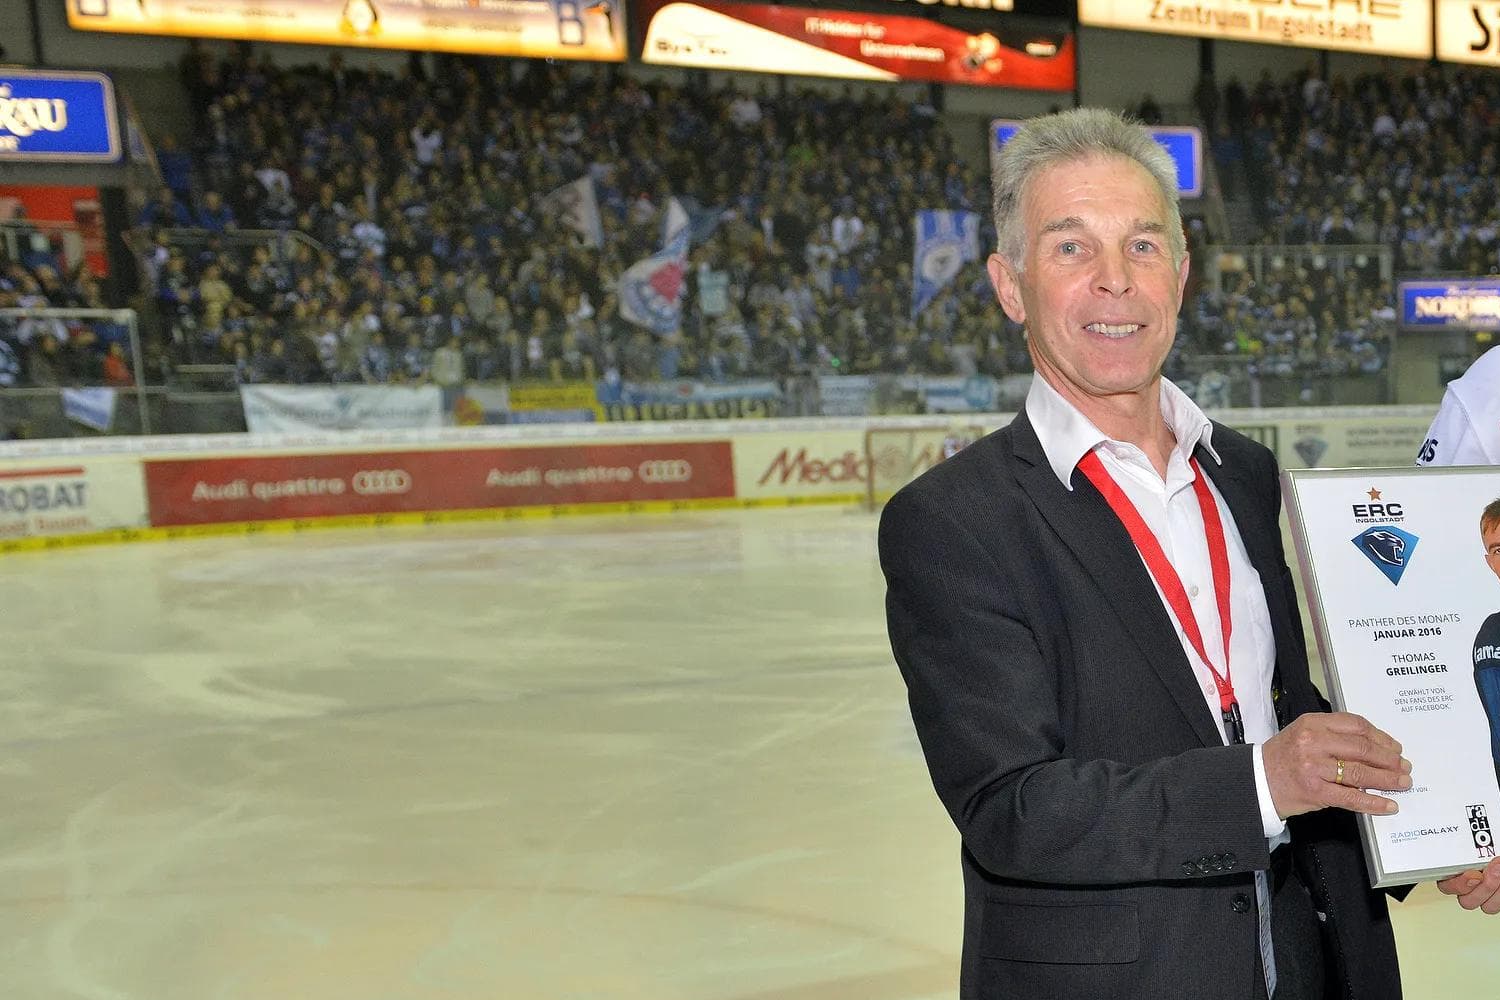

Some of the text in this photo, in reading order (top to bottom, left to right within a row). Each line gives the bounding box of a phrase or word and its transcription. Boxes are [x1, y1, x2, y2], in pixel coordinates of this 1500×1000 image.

[1149, 1, 1250, 27] Zentrum
[1352, 503, 1404, 517] ERC
[1348, 613, 1461, 629] PANTHER DES MONATS
[1373, 627, 1442, 641] JANUAR 2016
[1392, 652, 1436, 663] THOMAS
[1385, 664, 1448, 677] GREILINGER
[1398, 687, 1446, 697] GEWÄHLT VON
[1394, 698, 1408, 706] DEN
[1409, 697, 1427, 705] FANS
[1440, 694, 1454, 702] ERC
[1401, 705, 1414, 713] AUF
